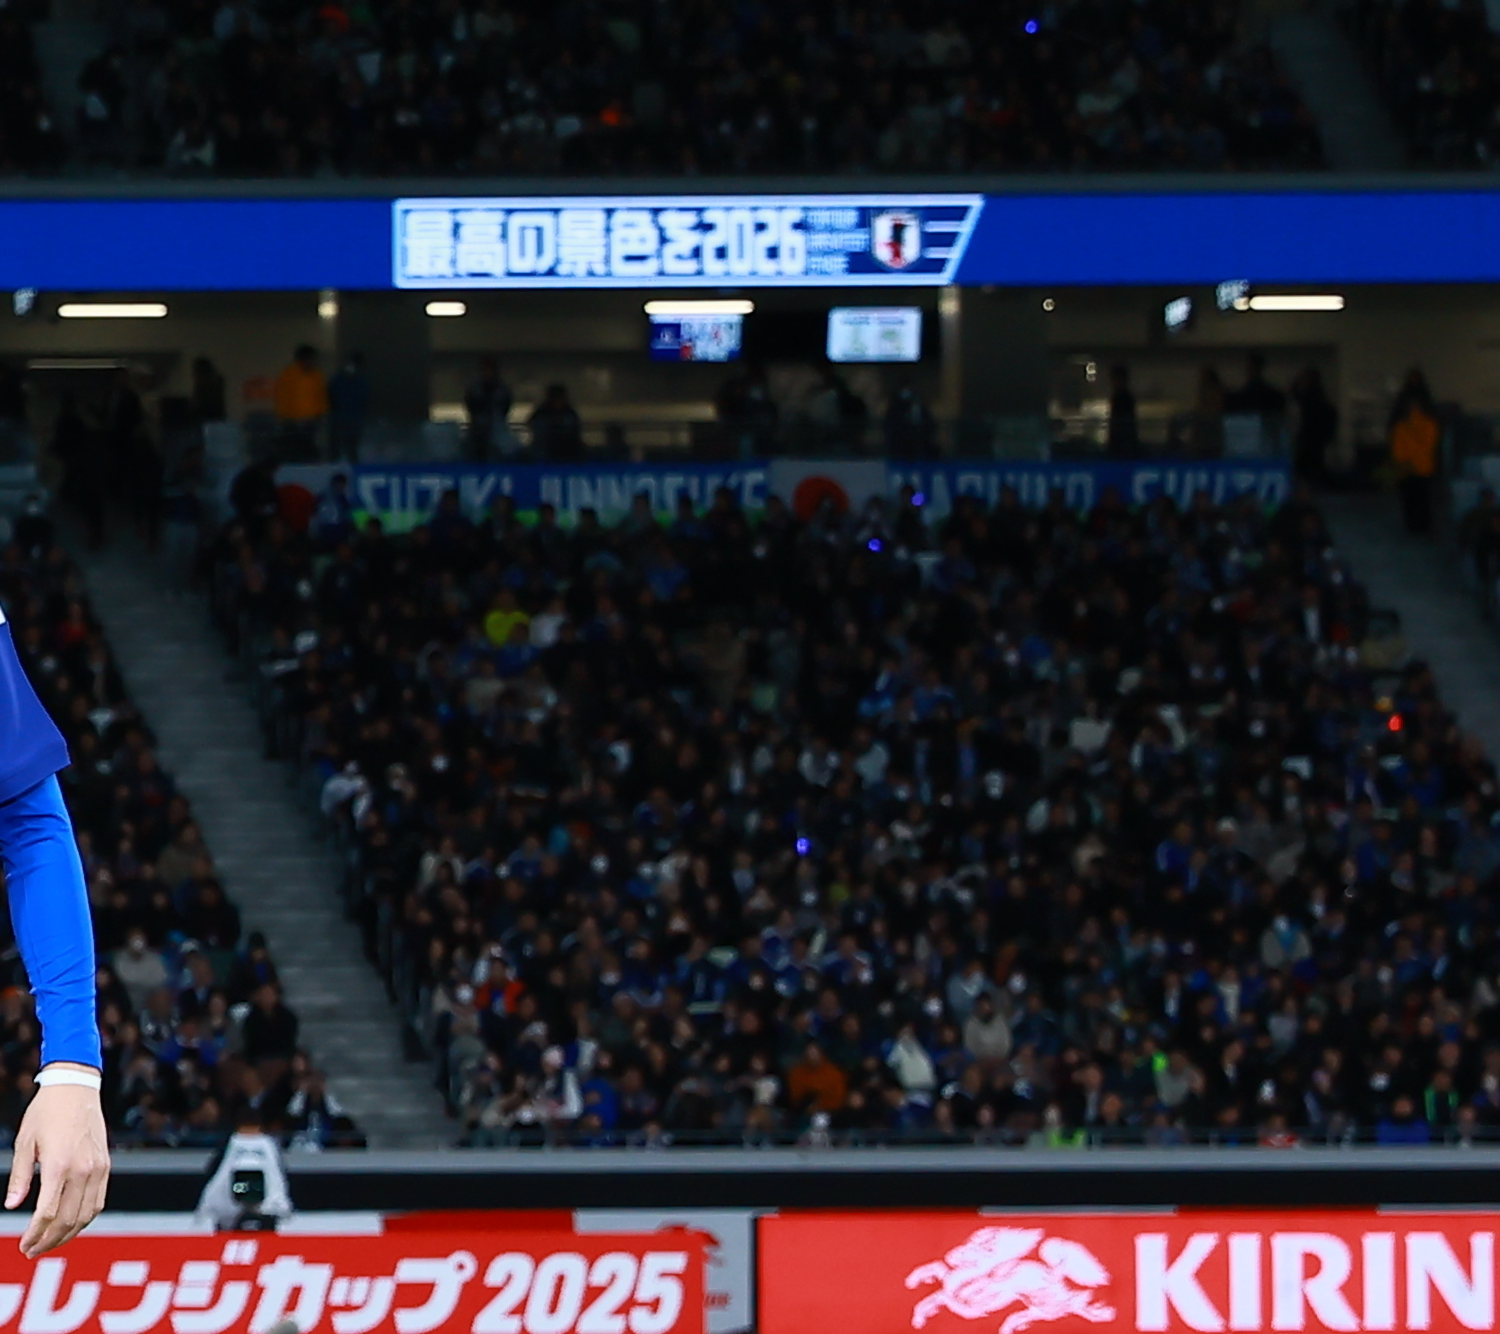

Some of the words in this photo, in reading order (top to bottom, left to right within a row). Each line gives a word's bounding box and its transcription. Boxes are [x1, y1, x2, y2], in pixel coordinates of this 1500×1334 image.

[405, 209, 806, 278] 最高の景色を2026
[1134, 1231, 1496, 1333] KIRIN
